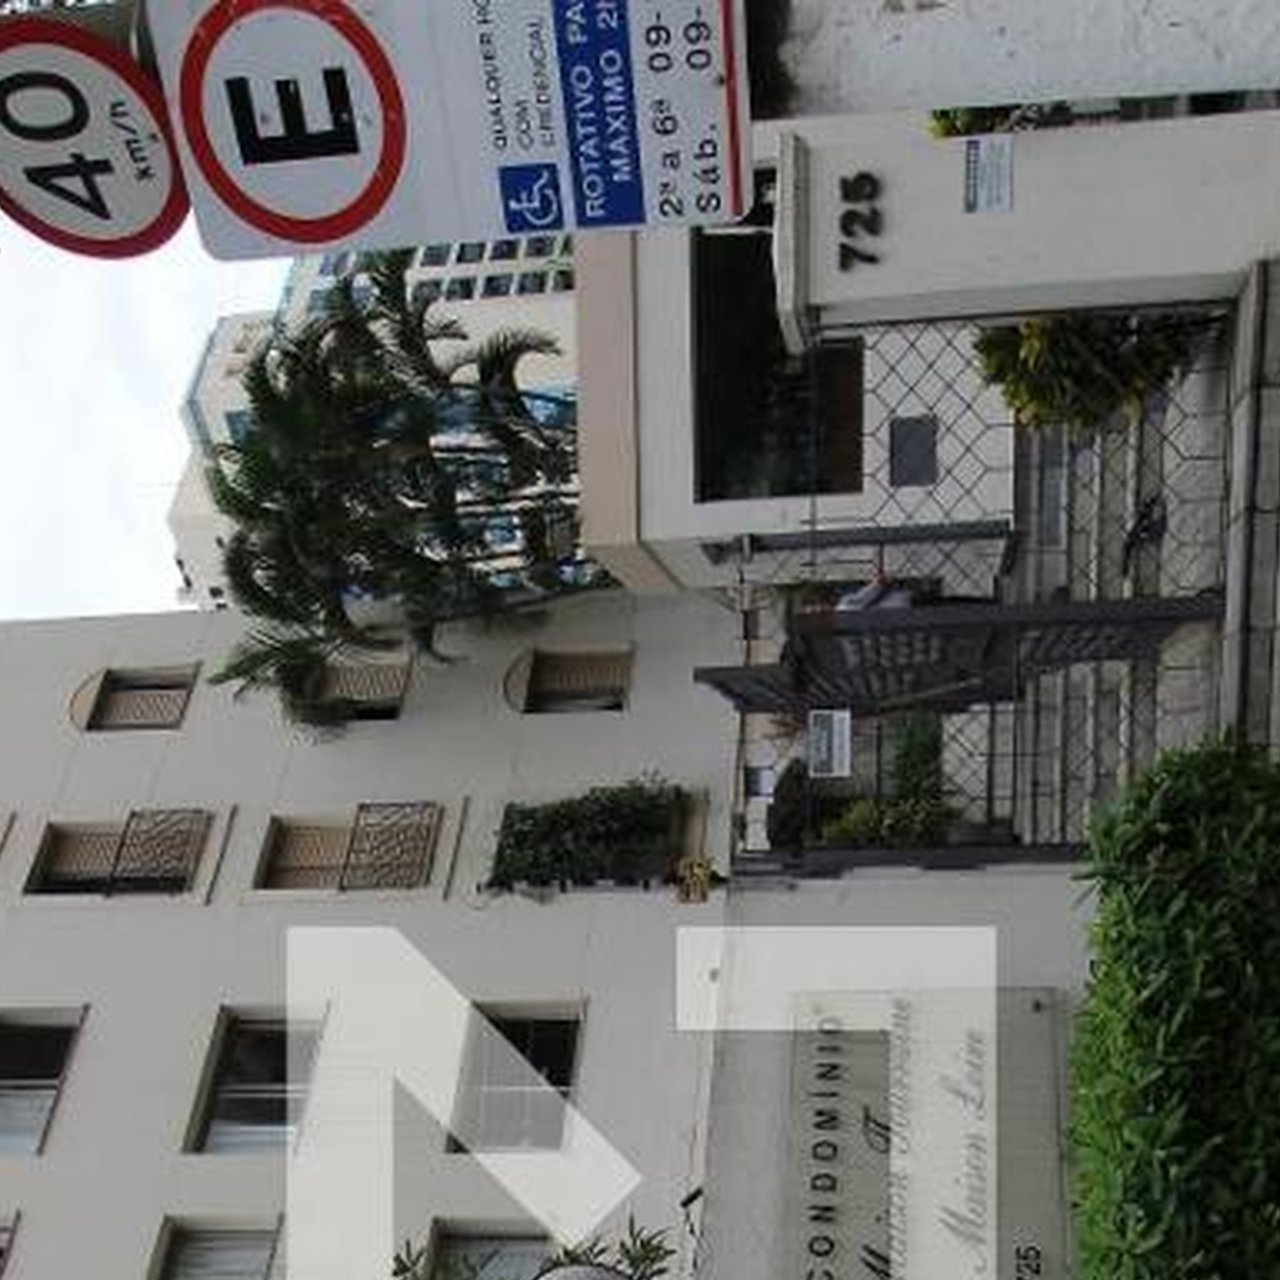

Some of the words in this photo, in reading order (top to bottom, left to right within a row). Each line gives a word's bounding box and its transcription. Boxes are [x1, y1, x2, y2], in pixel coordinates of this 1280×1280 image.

[565, 0, 588, 44] PA
[224, 67, 360, 166] E
[478, 32, 507, 149] QUALQUER
[514, 100, 534, 151] COM
[107, 101, 154, 183] km/h
[570, 64, 606, 218] ROTATIVO
[662, 150, 681, 170] a
[693, 123, 721, 213] Sáb.
[837, 171, 881, 272] 725
[937, 1133, 987, 1274] Maison
